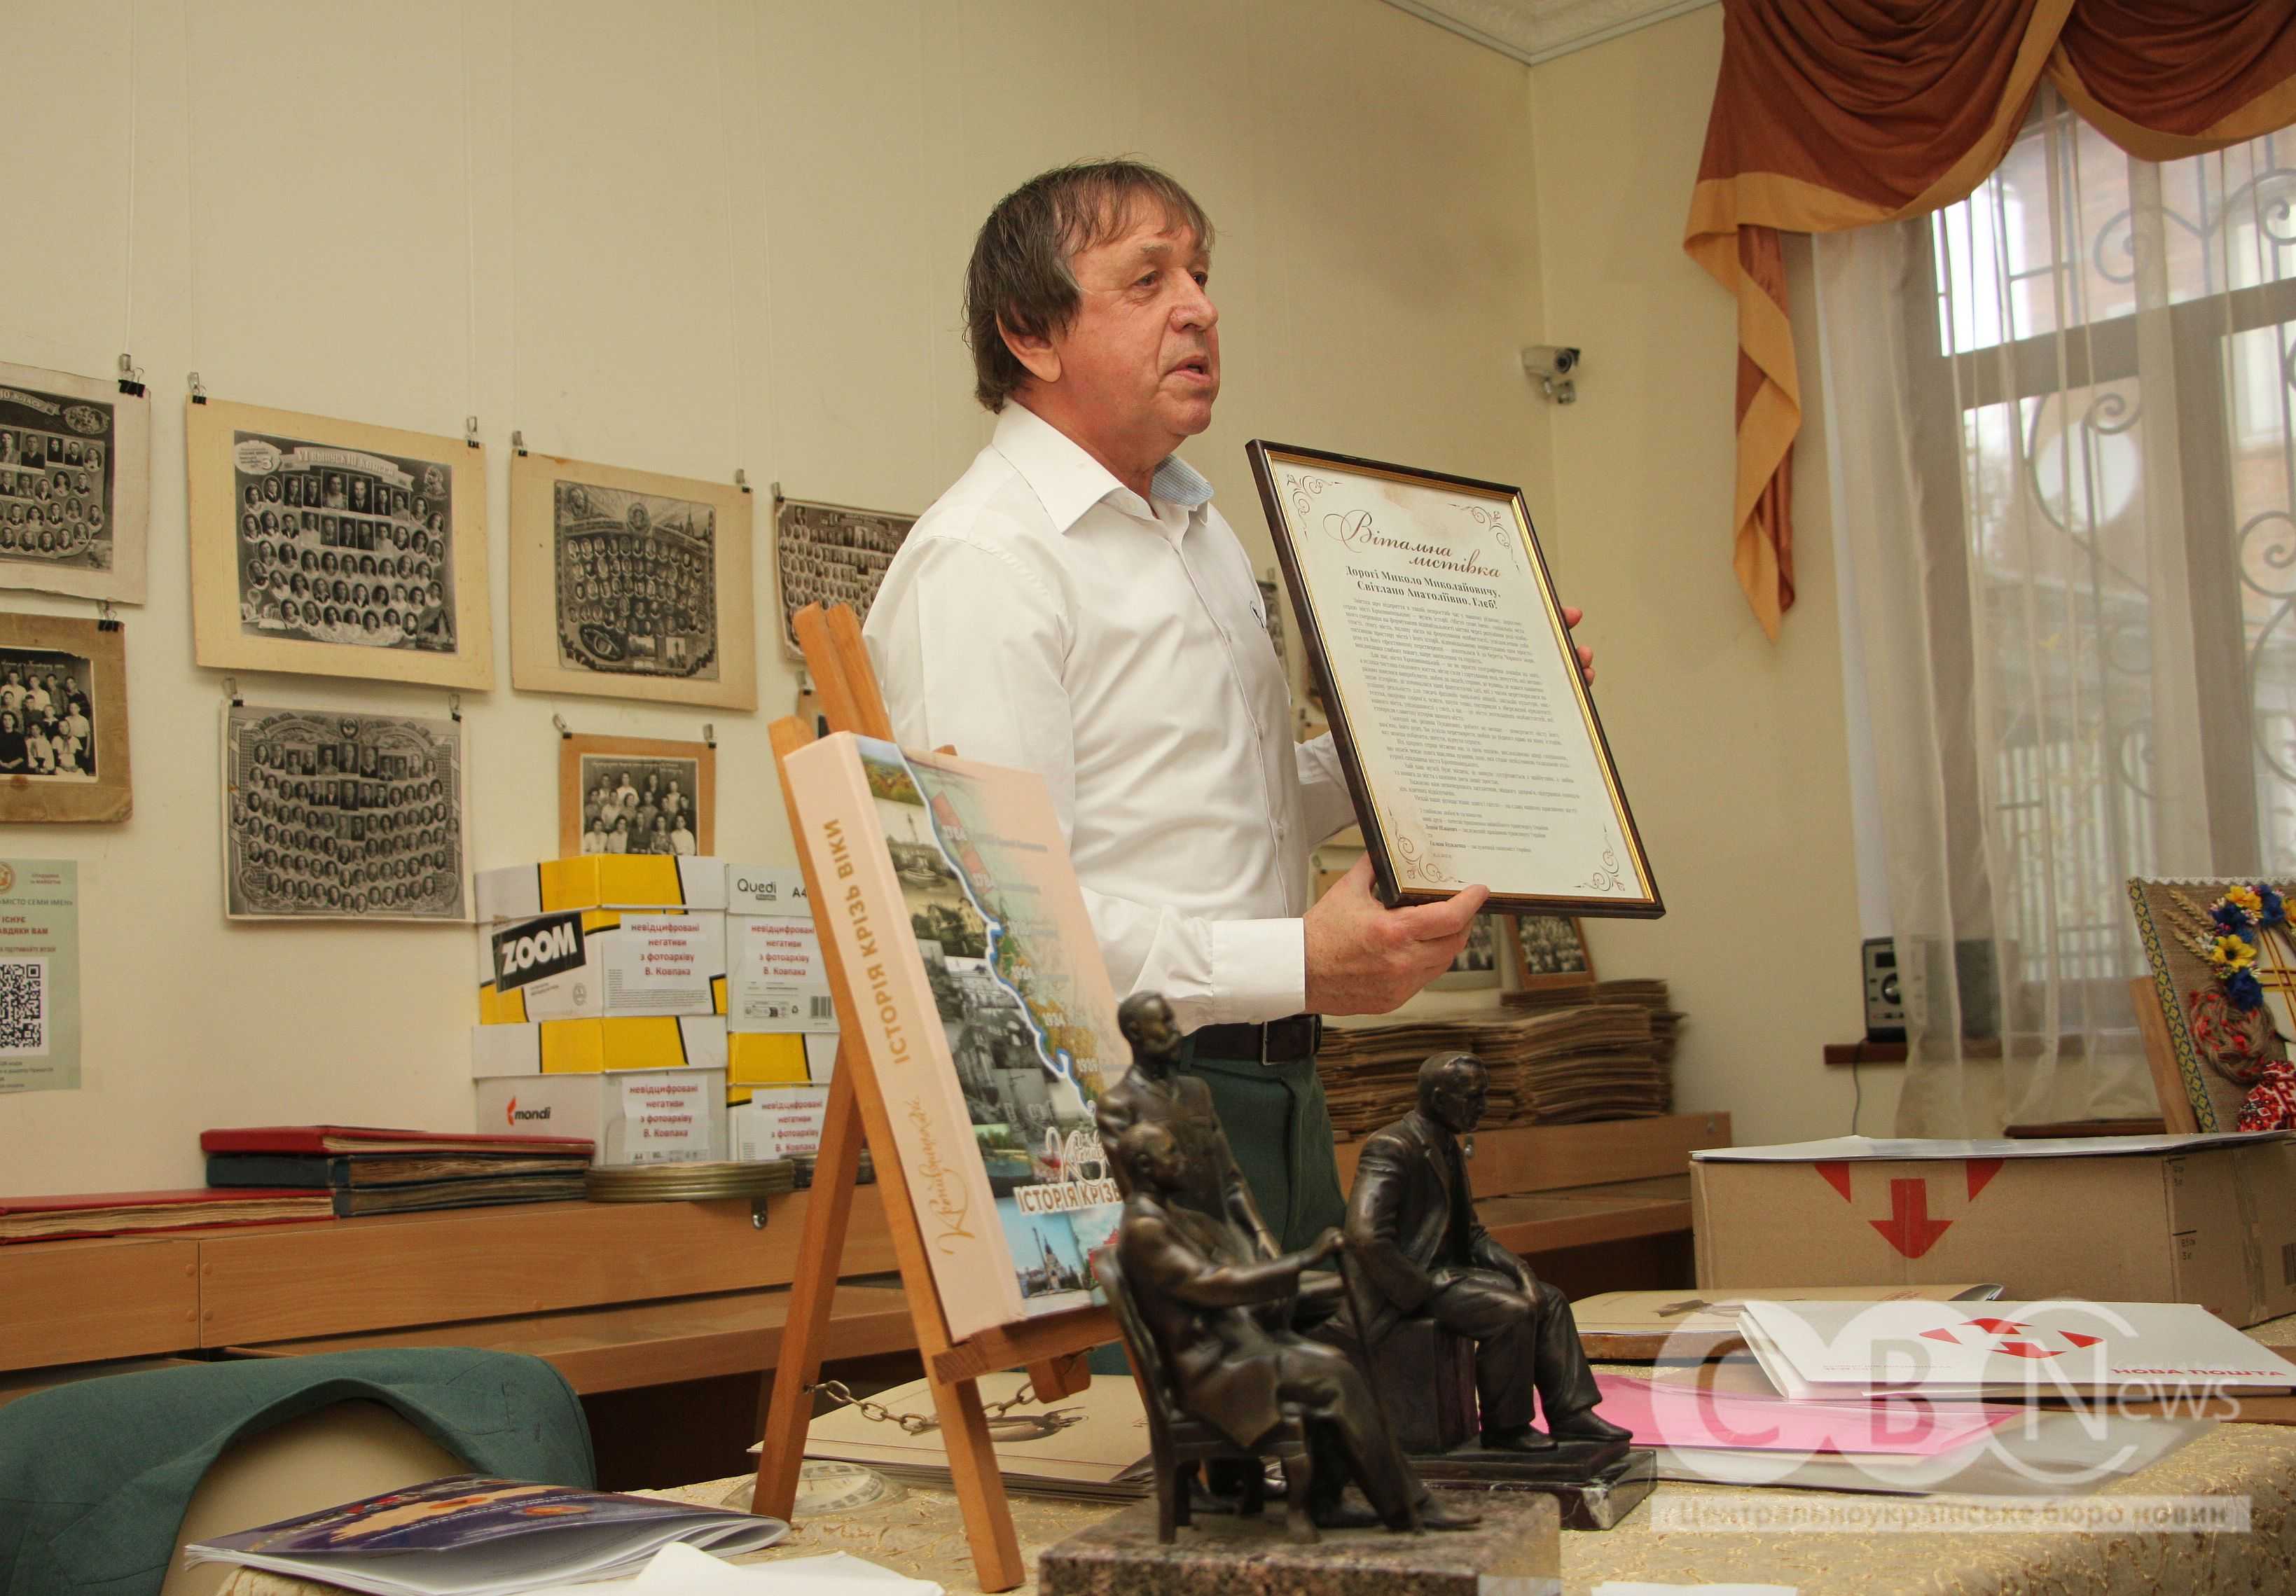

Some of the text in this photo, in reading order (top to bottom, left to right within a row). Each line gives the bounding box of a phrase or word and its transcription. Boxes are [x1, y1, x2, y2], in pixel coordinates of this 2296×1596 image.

[1322, 510, 1453, 557] Вітальна
[1346, 565, 1378, 581] Дорогі
[1381, 571, 1423, 585] Миколо
[1409, 548, 1501, 578] листівка
[1357, 581, 1404, 596] Світлано
[824, 819, 854, 880] ВІКИ
[738, 878, 777, 894] Quedi
[631, 922, 700, 933] невідцифровані
[845, 884, 878, 958] КРІЗЬ
[502, 922, 577, 976] ZOOM
[647, 952, 695, 964] фотоархіву
[656, 967, 691, 976] Ковпака
[866, 964, 910, 1064] ІСТОРІЯ
[515, 1106, 551, 1120] mondi
[1018, 1181, 1121, 1212] ІСТОРІЯ КРІЗЬ
